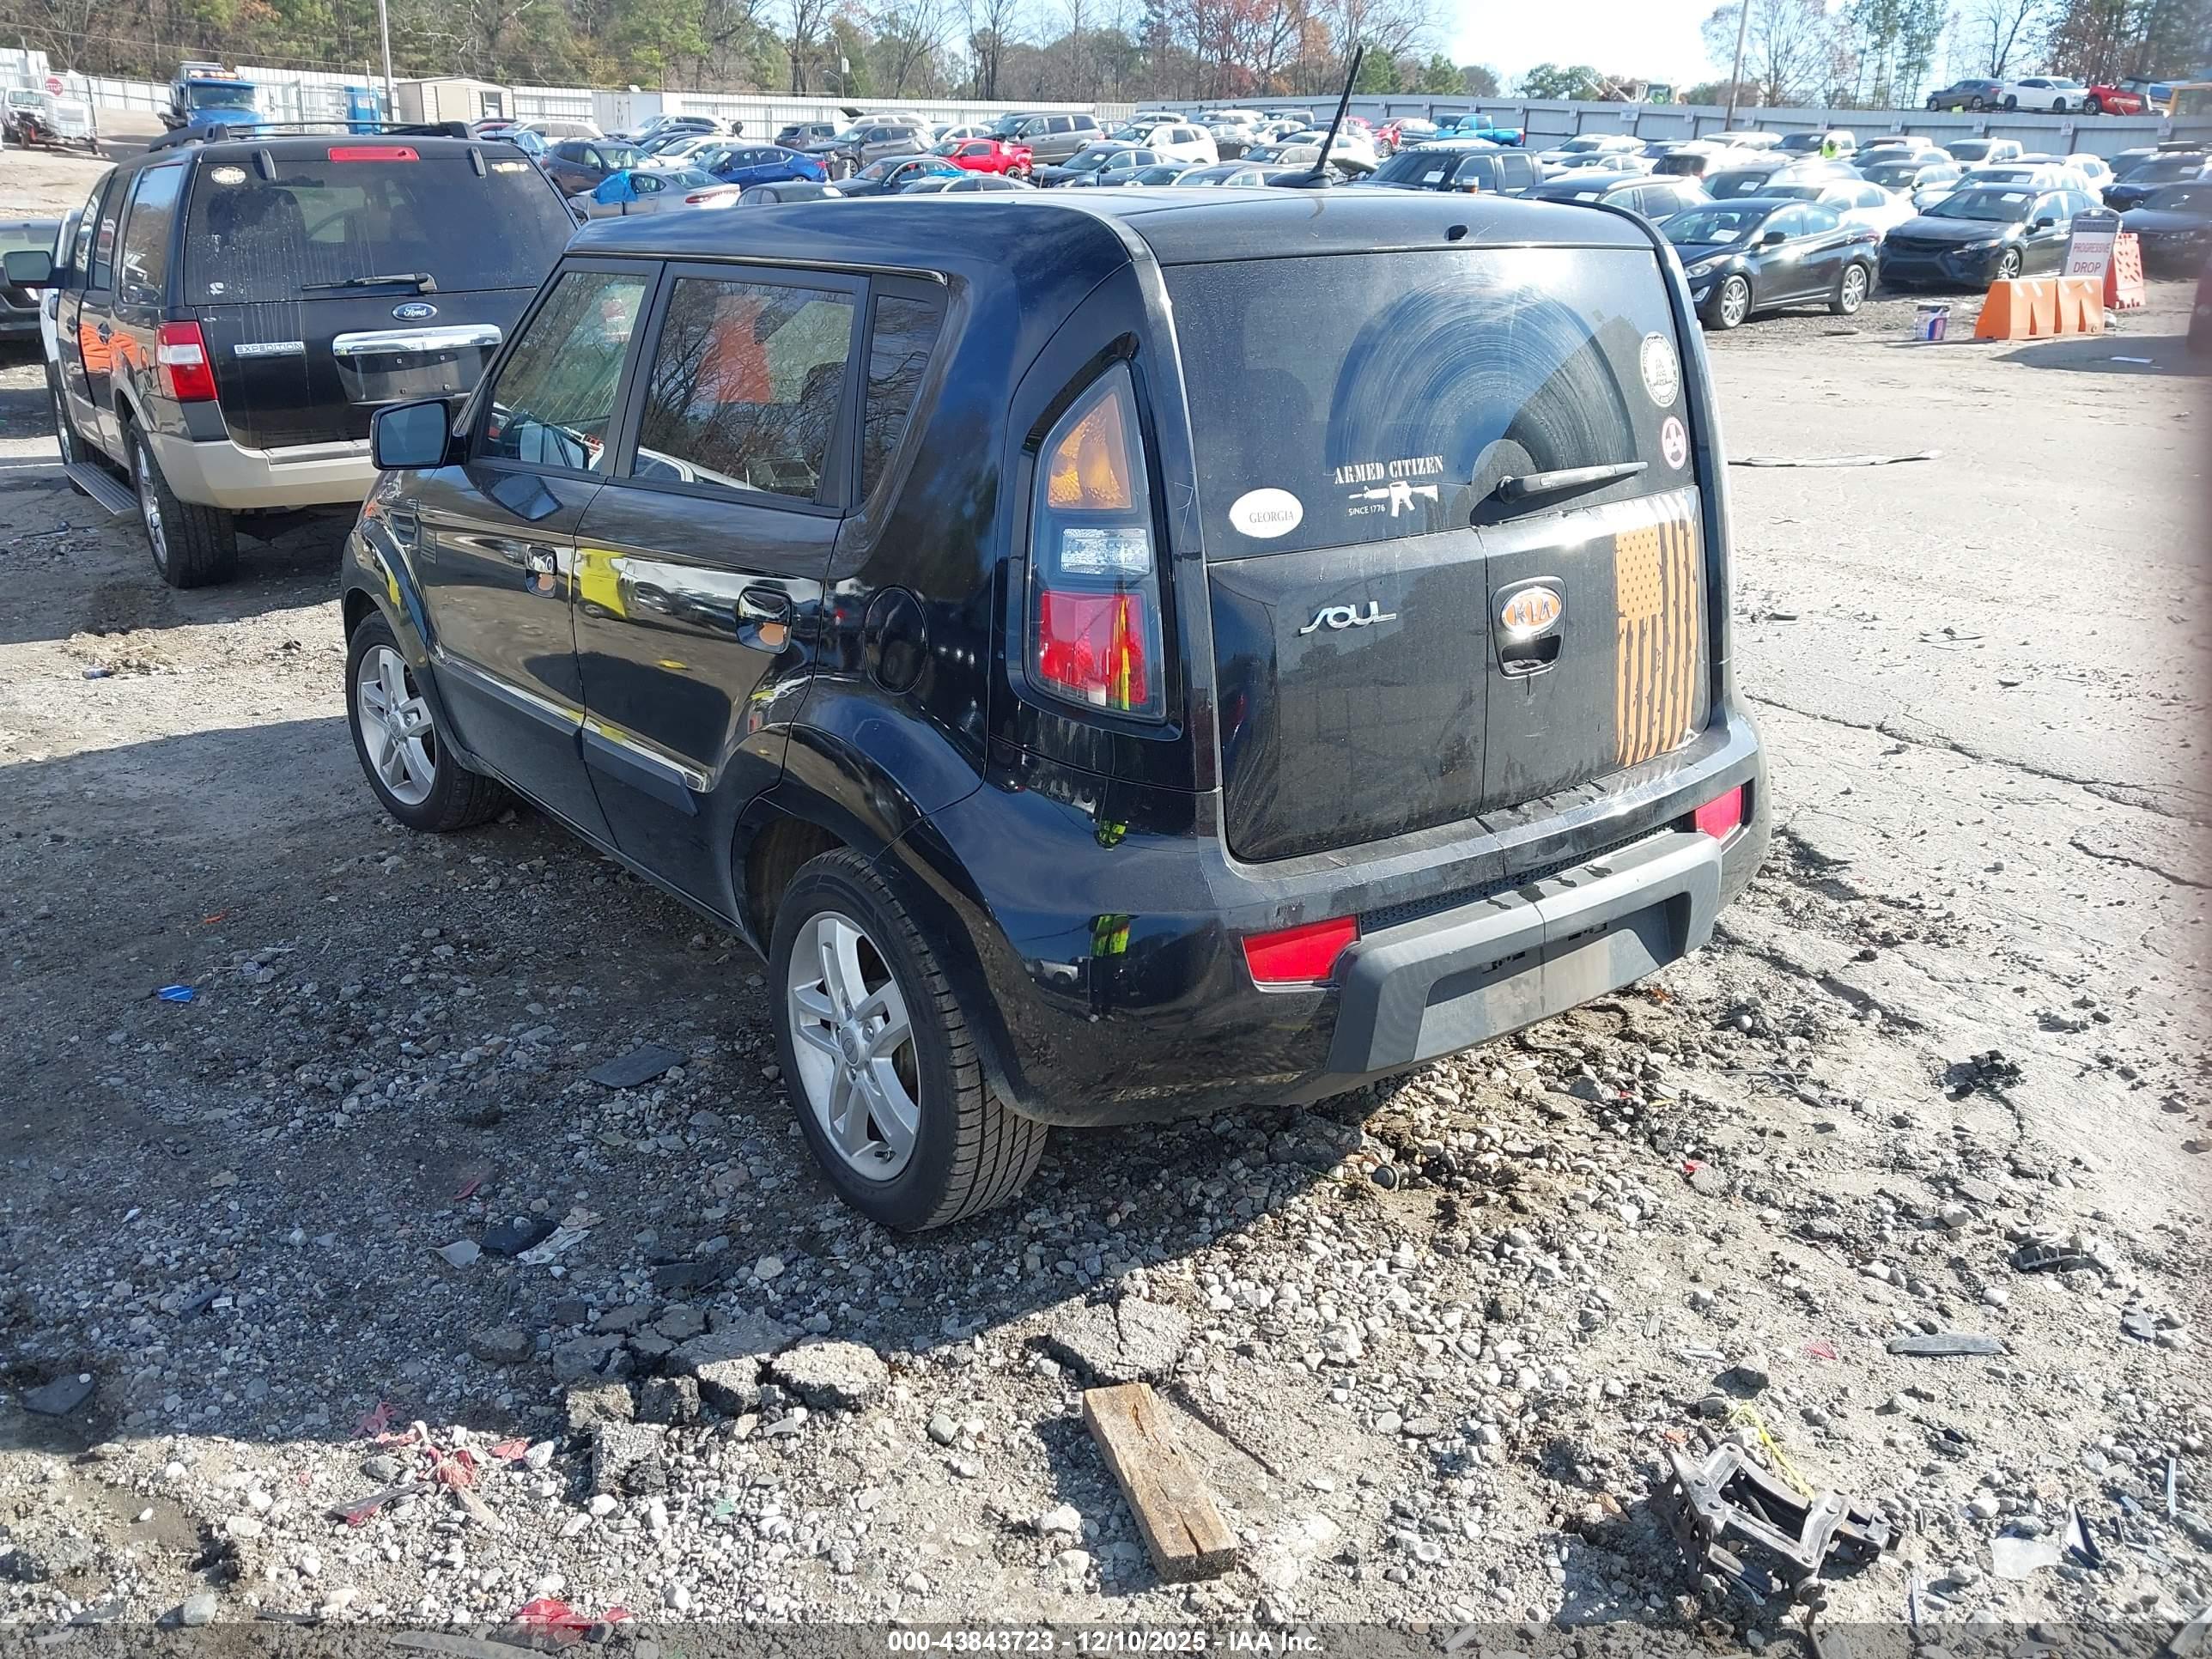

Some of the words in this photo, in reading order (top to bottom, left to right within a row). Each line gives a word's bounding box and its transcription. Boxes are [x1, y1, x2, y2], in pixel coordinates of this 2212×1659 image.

[46, 82, 63, 91] STOP
[2073, 262, 2101, 273] DROP
[404, 306, 428, 317] Ford
[236, 343, 302, 353] EXPEDITION
[1334, 461, 1384, 484] ARMED
[1389, 455, 1443, 478] CITIZEN
[1348, 507, 1370, 515] SINCE
[1370, 505, 1386, 514] 1776
[1249, 510, 1295, 523] GEORGIA
[1298, 600, 1396, 635] SOUL
[1512, 599, 1553, 626] KIA
